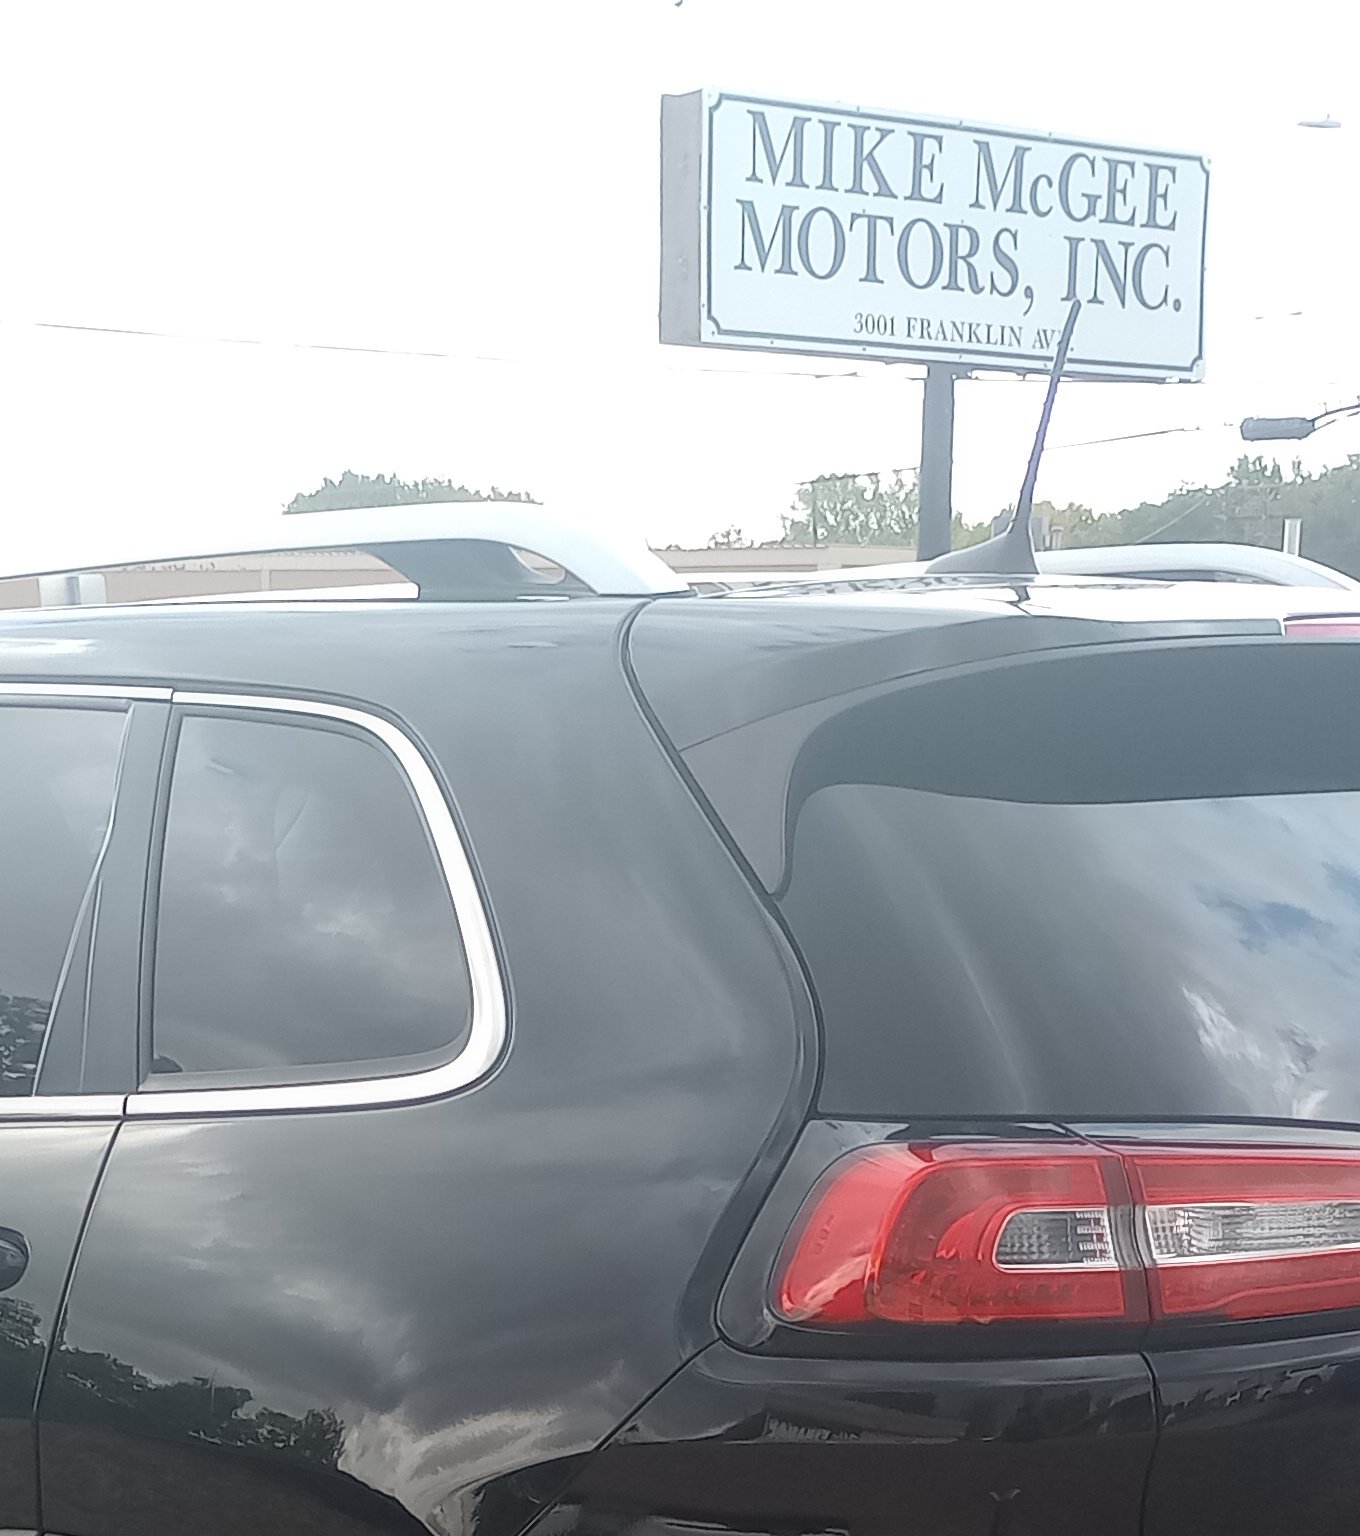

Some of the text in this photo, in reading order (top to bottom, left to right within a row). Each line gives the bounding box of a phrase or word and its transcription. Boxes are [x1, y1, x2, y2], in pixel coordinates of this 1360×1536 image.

[745, 109, 1178, 231] MIKE McGEE
[734, 198, 1183, 317] MOTORS, INC.
[853, 312, 1074, 352] 3001 FRANKLIN AV.
